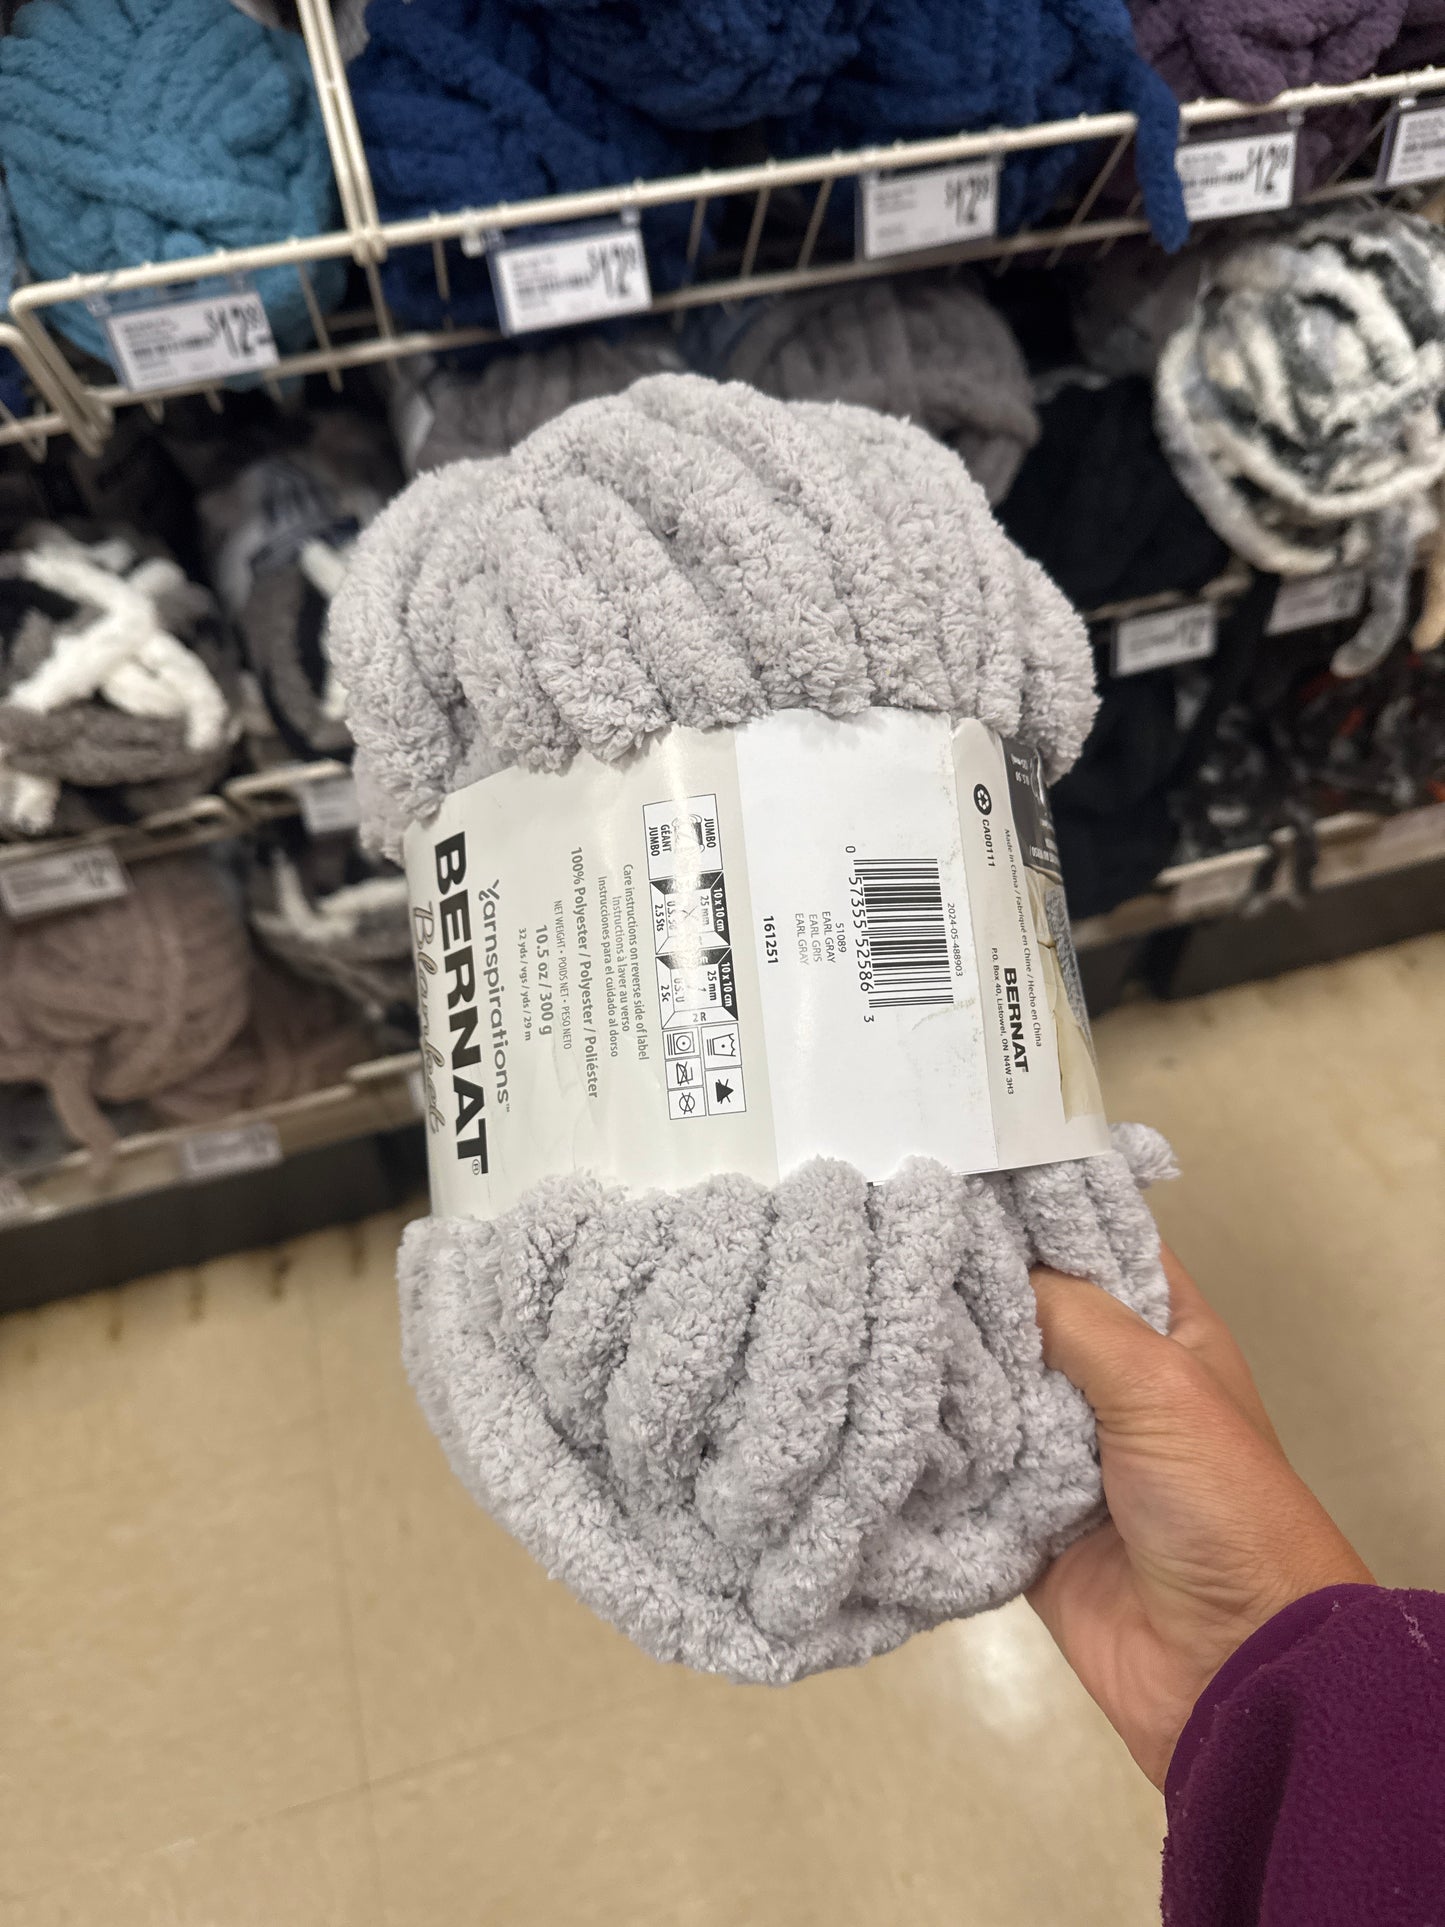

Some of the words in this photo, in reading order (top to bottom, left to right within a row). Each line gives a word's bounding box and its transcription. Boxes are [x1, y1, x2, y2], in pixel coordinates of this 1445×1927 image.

[648, 827, 660, 856] JUMBO
[660, 824, 672, 852] GÉANT
[704, 818, 717, 848] JUMBO
[982, 819, 996, 867] CA00111
[1004, 828, 1013, 853] Made
[845, 845, 856, 853] 0
[1009, 854, 1014, 863] in
[571, 847, 585, 885] 100%
[623, 864, 634, 886] Care
[1010, 864, 1019, 888] China
[700, 895, 710, 906] 25
[713, 887, 723, 899] 10
[848, 876, 867, 929] 57355
[553, 900, 563, 915] NET
[572, 886, 588, 950] Polyester
[598, 876, 610, 940] Instrucciones
[625, 887, 638, 946] instructions
[654, 904, 664, 917] 2.5
[702, 908, 710, 925] mm
[715, 906, 725, 918] 10
[1015, 896, 1027, 933] Fabriqué
[518, 928, 527, 940] 32
[555, 916, 566, 948] WEIGHT
[612, 895, 625, 955] Instructions
[656, 918, 665, 932] Sts
[716, 919, 725, 932] cm
[795, 913, 806, 938] EARL
[808, 914, 820, 938] EARL
[822, 911, 833, 935] EARL
[535, 924, 550, 958] 10.5
[763, 915, 779, 964] 161251
[835, 923, 847, 953] 51089
[947, 903, 964, 977] 2024-05-488903
[1022, 935, 1028, 946] en
[517, 941, 528, 959] yds
[600, 941, 612, 964] para
[629, 947, 638, 960] on
[798, 939, 809, 965] GRAY
[811, 940, 823, 962] GRIS
[824, 937, 836, 963] GRAY
[991, 947, 999, 962] P.O.
[1024, 947, 1032, 972] Chine
[519, 966, 528, 984] vgs
[538, 962, 548, 980] oz
[558, 956, 568, 981] POIDS
[605, 965, 615, 975] el
[617, 963, 628, 989] laver
[707, 970, 717, 982] 25
[721, 962, 731, 973] 10
[855, 939, 874, 992] 52586
[560, 982, 569, 997] NET
[631, 962, 641, 998] reverse
[723, 981, 733, 993] 10
[520, 991, 531, 1009] yds
[578, 960, 593, 1024] Polyester
[605, 977, 617, 1016] cuidado
[619, 990, 628, 1003] au
[661, 992, 671, 1002] Sc
[708, 983, 717, 1001] mm
[724, 994, 732, 1007] cm
[1028, 980, 1036, 1008] Hecho
[539, 992, 554, 1021] 300
[561, 1006, 571, 1027] PESO
[633, 1000, 646, 1021] side
[997, 998, 1007, 1036] Listowel,
[1031, 1009, 1038, 1020] en
[523, 1016, 532, 1029] 29
[608, 1018, 619, 1028] al
[620, 1005, 630, 1032] verso
[636, 1022, 648, 1033] of
[863, 1015, 875, 1023] 3
[524, 1031, 531, 1041] m
[538, 1025, 552, 1035] g
[562, 1028, 572, 1050] NETO
[1033, 1022, 1042, 1047] China
[609, 1029, 619, 1057] dorso
[637, 1035, 650, 1060] label
[1001, 1038, 1009, 1051] ON
[584, 1036, 599, 1098] Poliéster
[1003, 1055, 1012, 1075] N4W
[1006, 1077, 1014, 1095] 3H3
